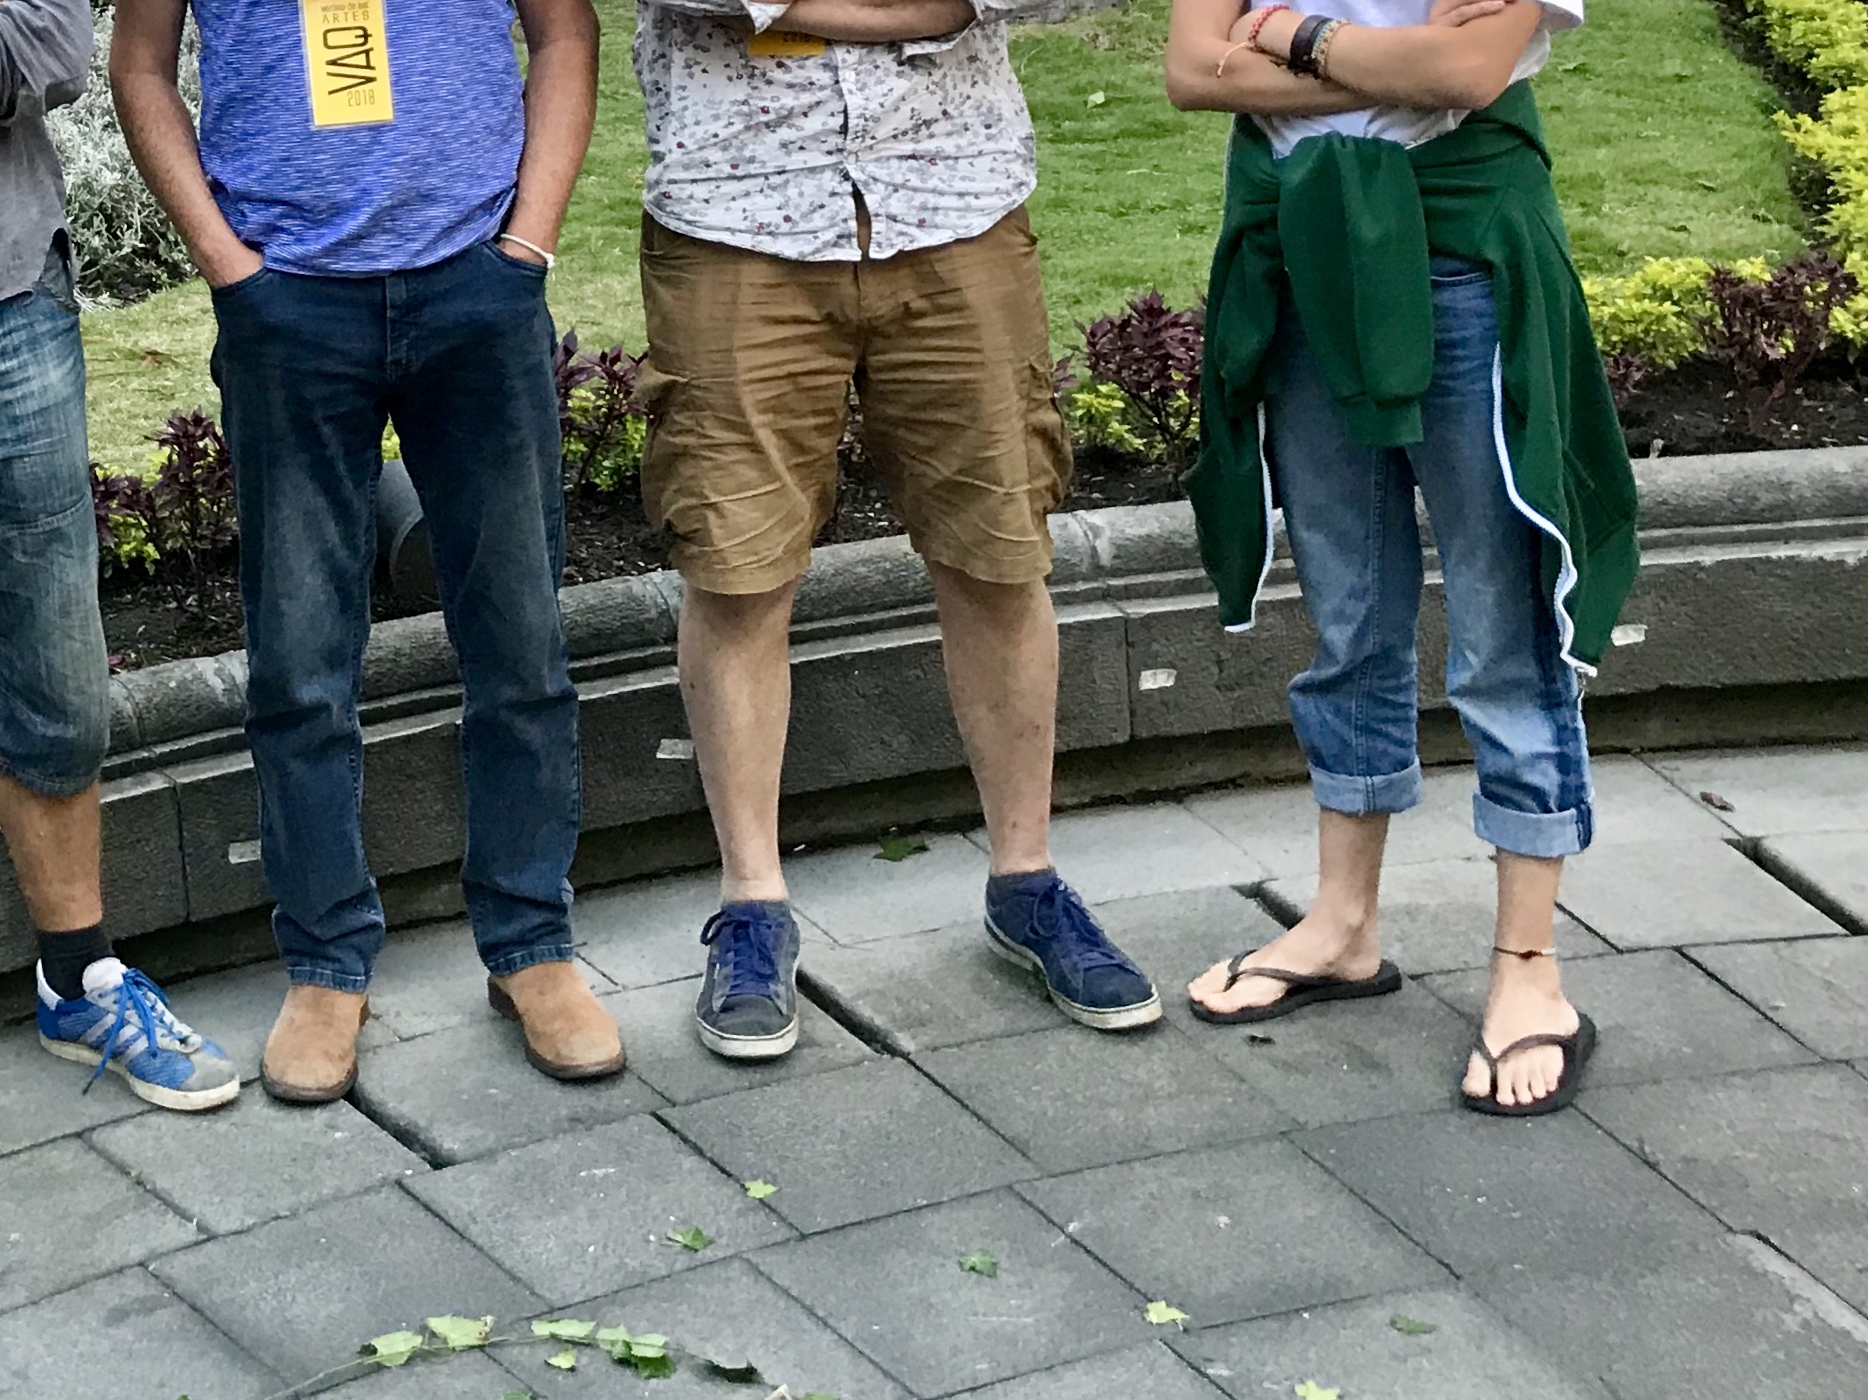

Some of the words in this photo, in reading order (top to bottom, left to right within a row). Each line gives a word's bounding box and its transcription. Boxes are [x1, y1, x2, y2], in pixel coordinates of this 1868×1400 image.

[322, 10, 369, 23] ARTES
[322, 25, 377, 95] VAQ
[347, 89, 375, 106] 2018
